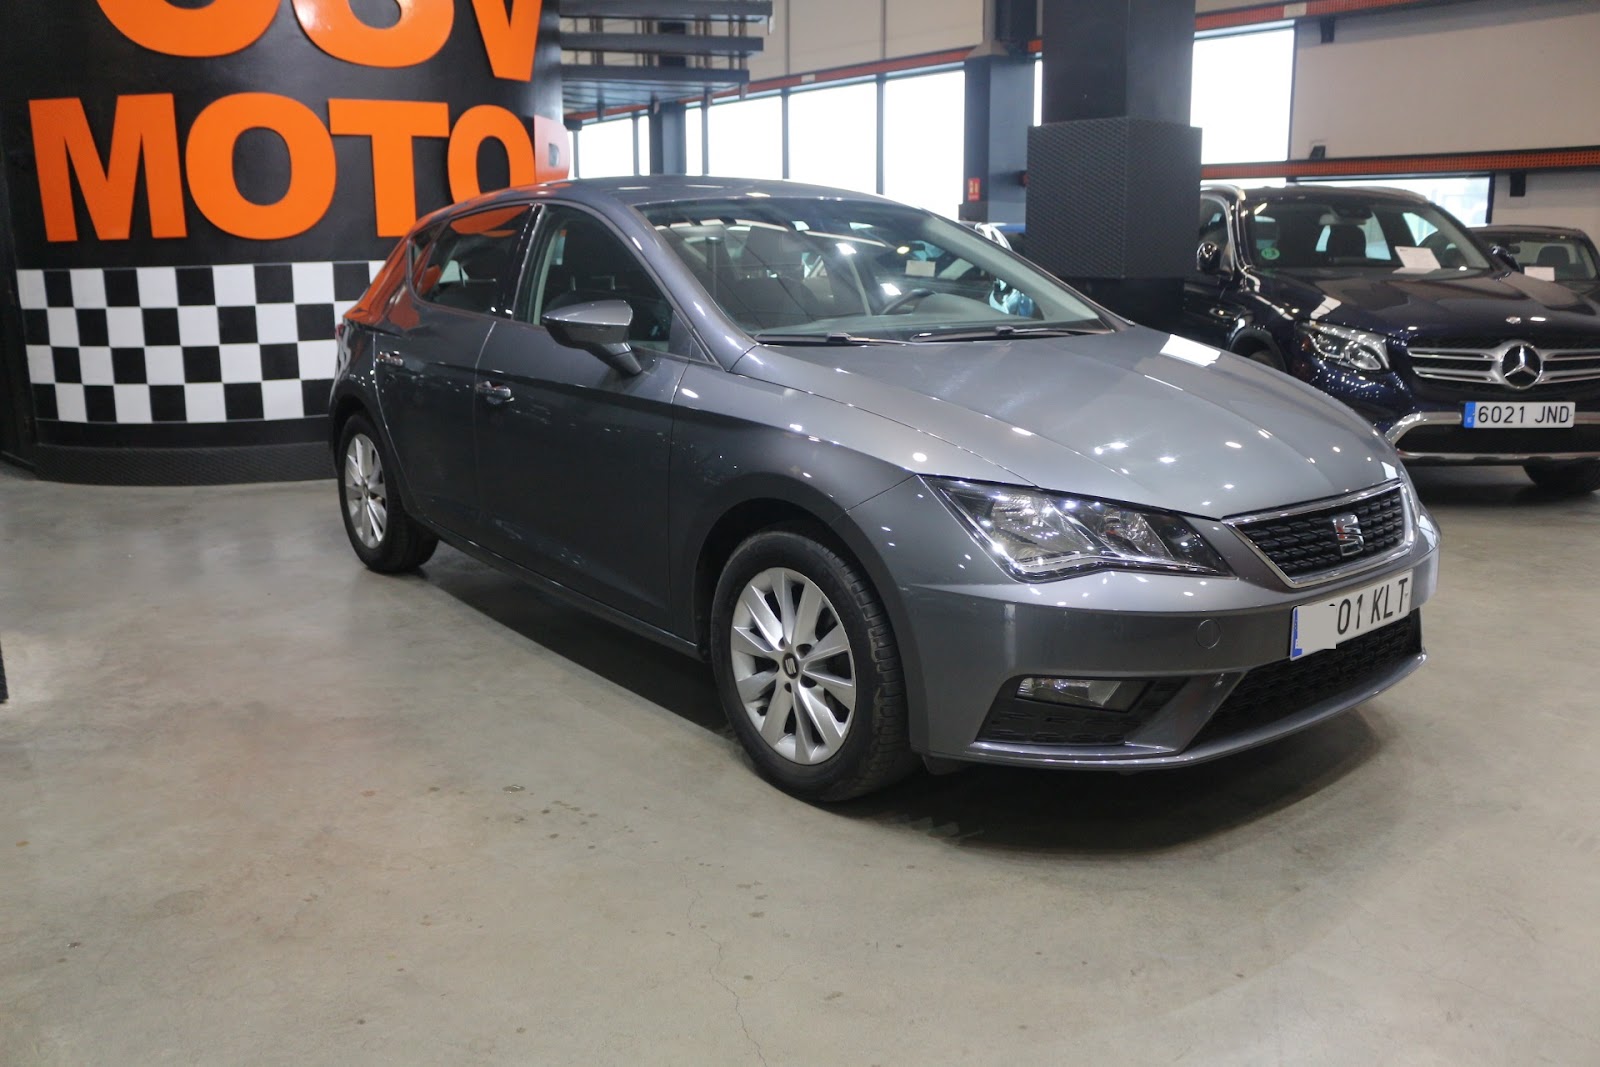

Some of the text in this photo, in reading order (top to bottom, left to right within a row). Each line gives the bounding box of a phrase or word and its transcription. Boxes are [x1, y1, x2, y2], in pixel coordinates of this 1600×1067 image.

[1478, 405, 1570, 423] 6021 JND
[1329, 577, 1408, 635] 01 KLT
